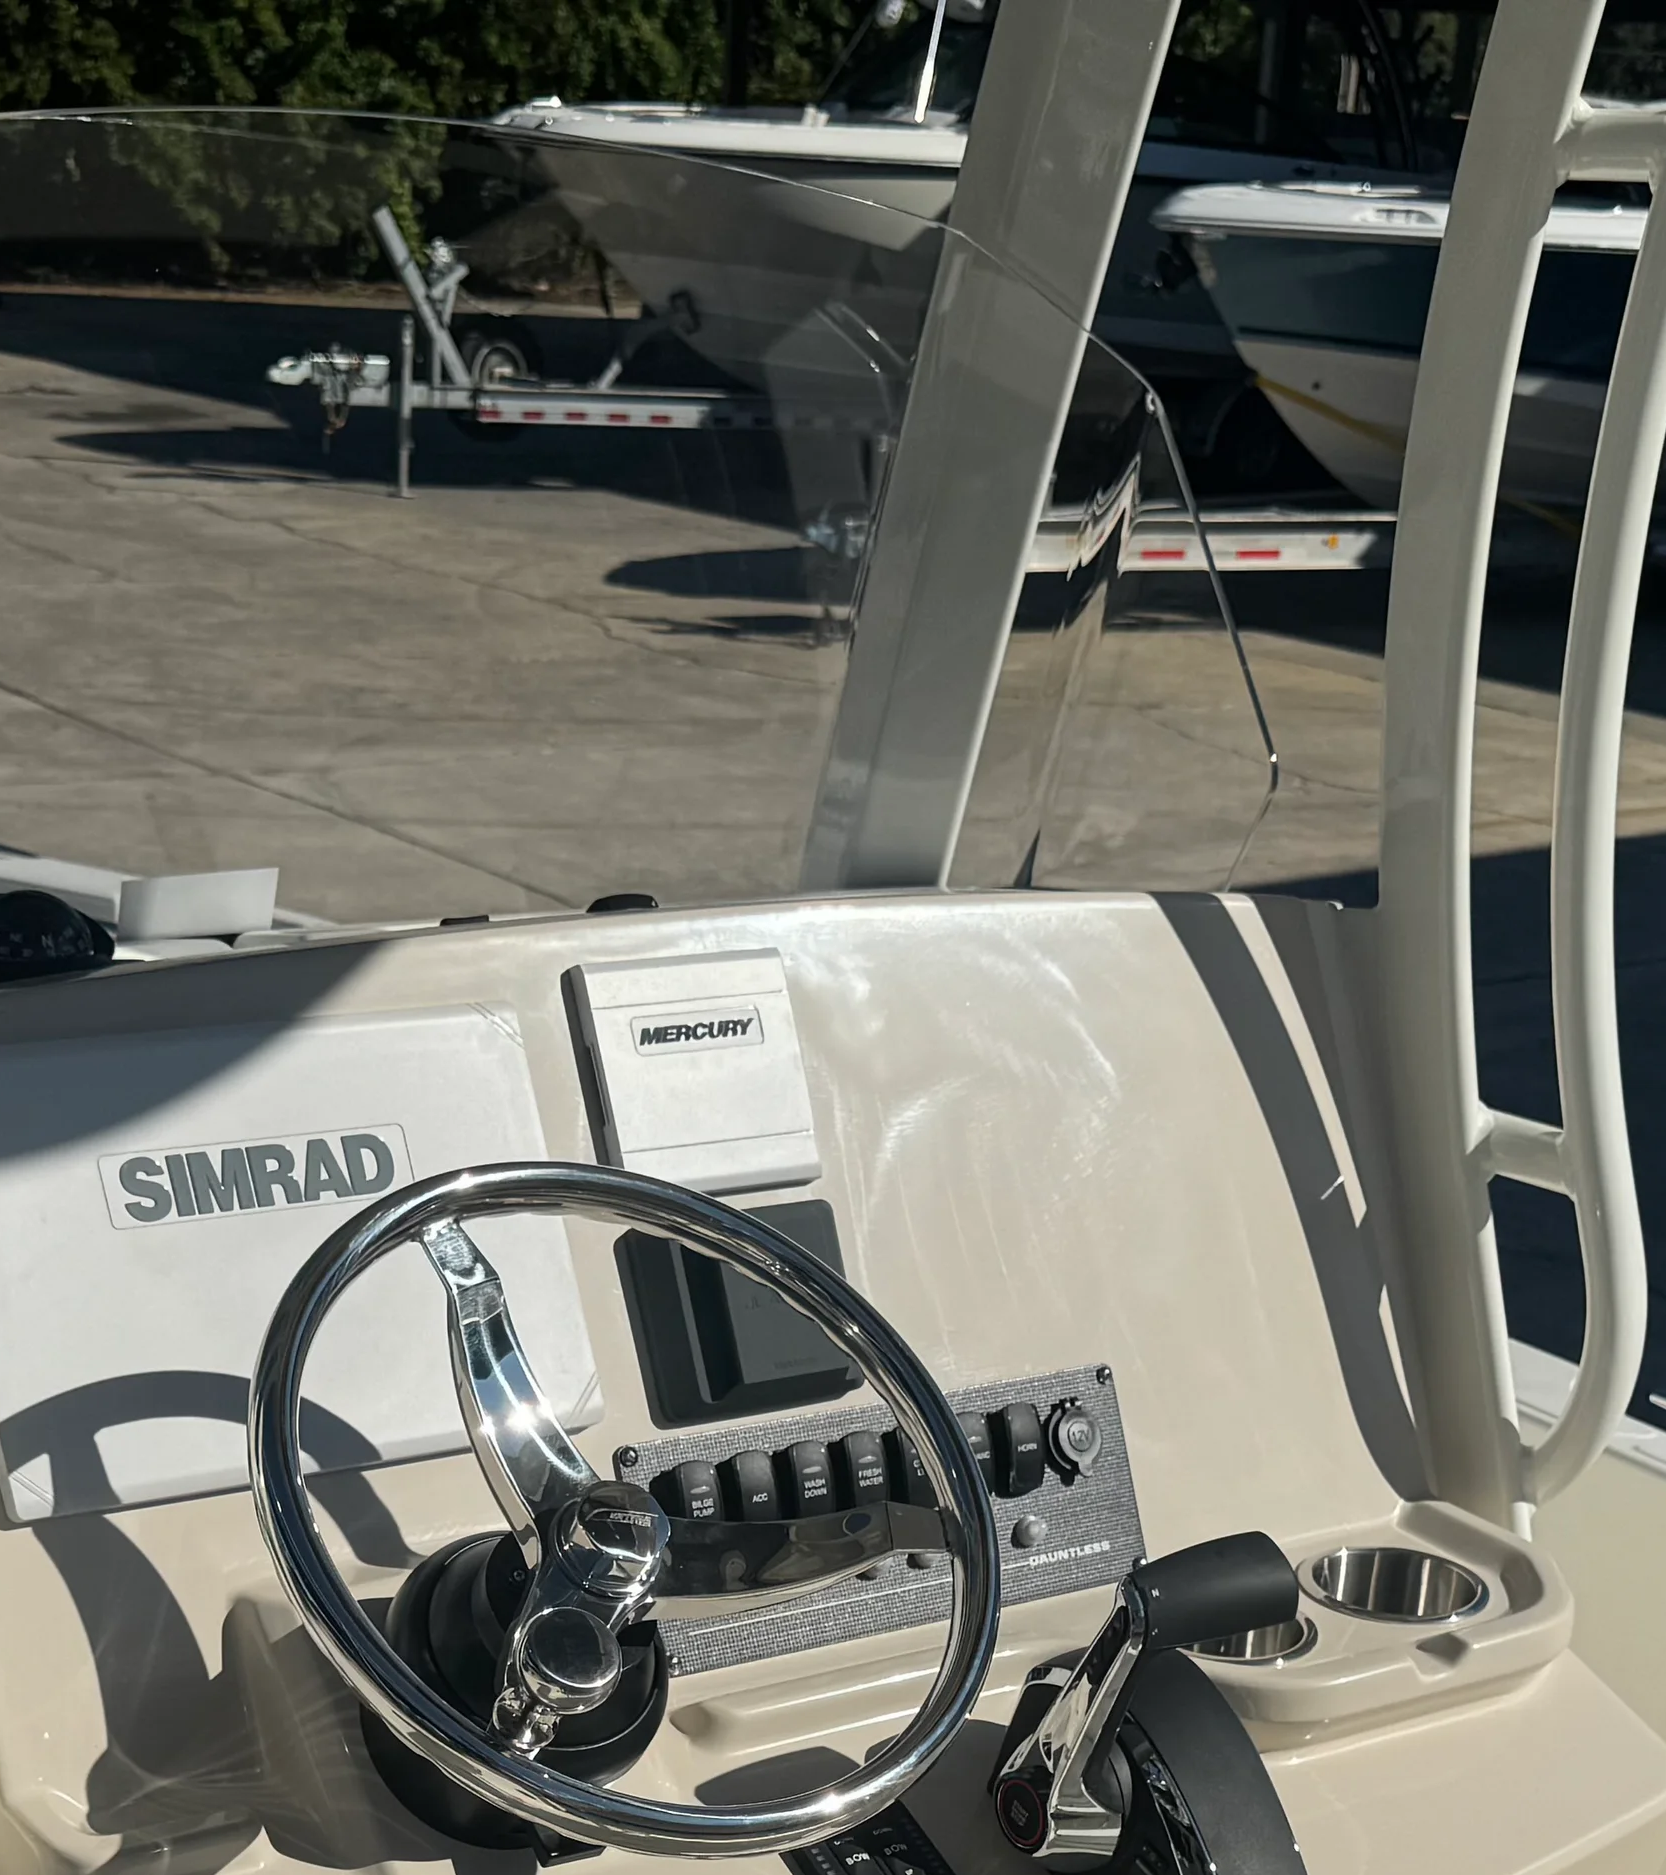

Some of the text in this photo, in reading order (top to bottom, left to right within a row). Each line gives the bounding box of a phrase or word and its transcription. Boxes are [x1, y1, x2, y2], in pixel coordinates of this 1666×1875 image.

[637, 1015, 754, 1048] MERCURY
[118, 1133, 395, 1223] SIMRAD
[1071, 1428, 1090, 1444] 12V
[1017, 1442, 1038, 1453] HORN
[858, 1466, 883, 1479] FRESH
[803, 1477, 826, 1490] WASH
[859, 1475, 884, 1488] WATER
[752, 1491, 769, 1503] ACC
[804, 1487, 828, 1499] DOWN
[691, 1497, 714, 1510] BILGE
[693, 1507, 715, 1519] PUMP
[1029, 1541, 1111, 1567] DAUNTLESS
[1151, 1588, 1160, 1598] N
[883, 1843, 908, 1856] BOW
[845, 1852, 871, 1866] BOW
